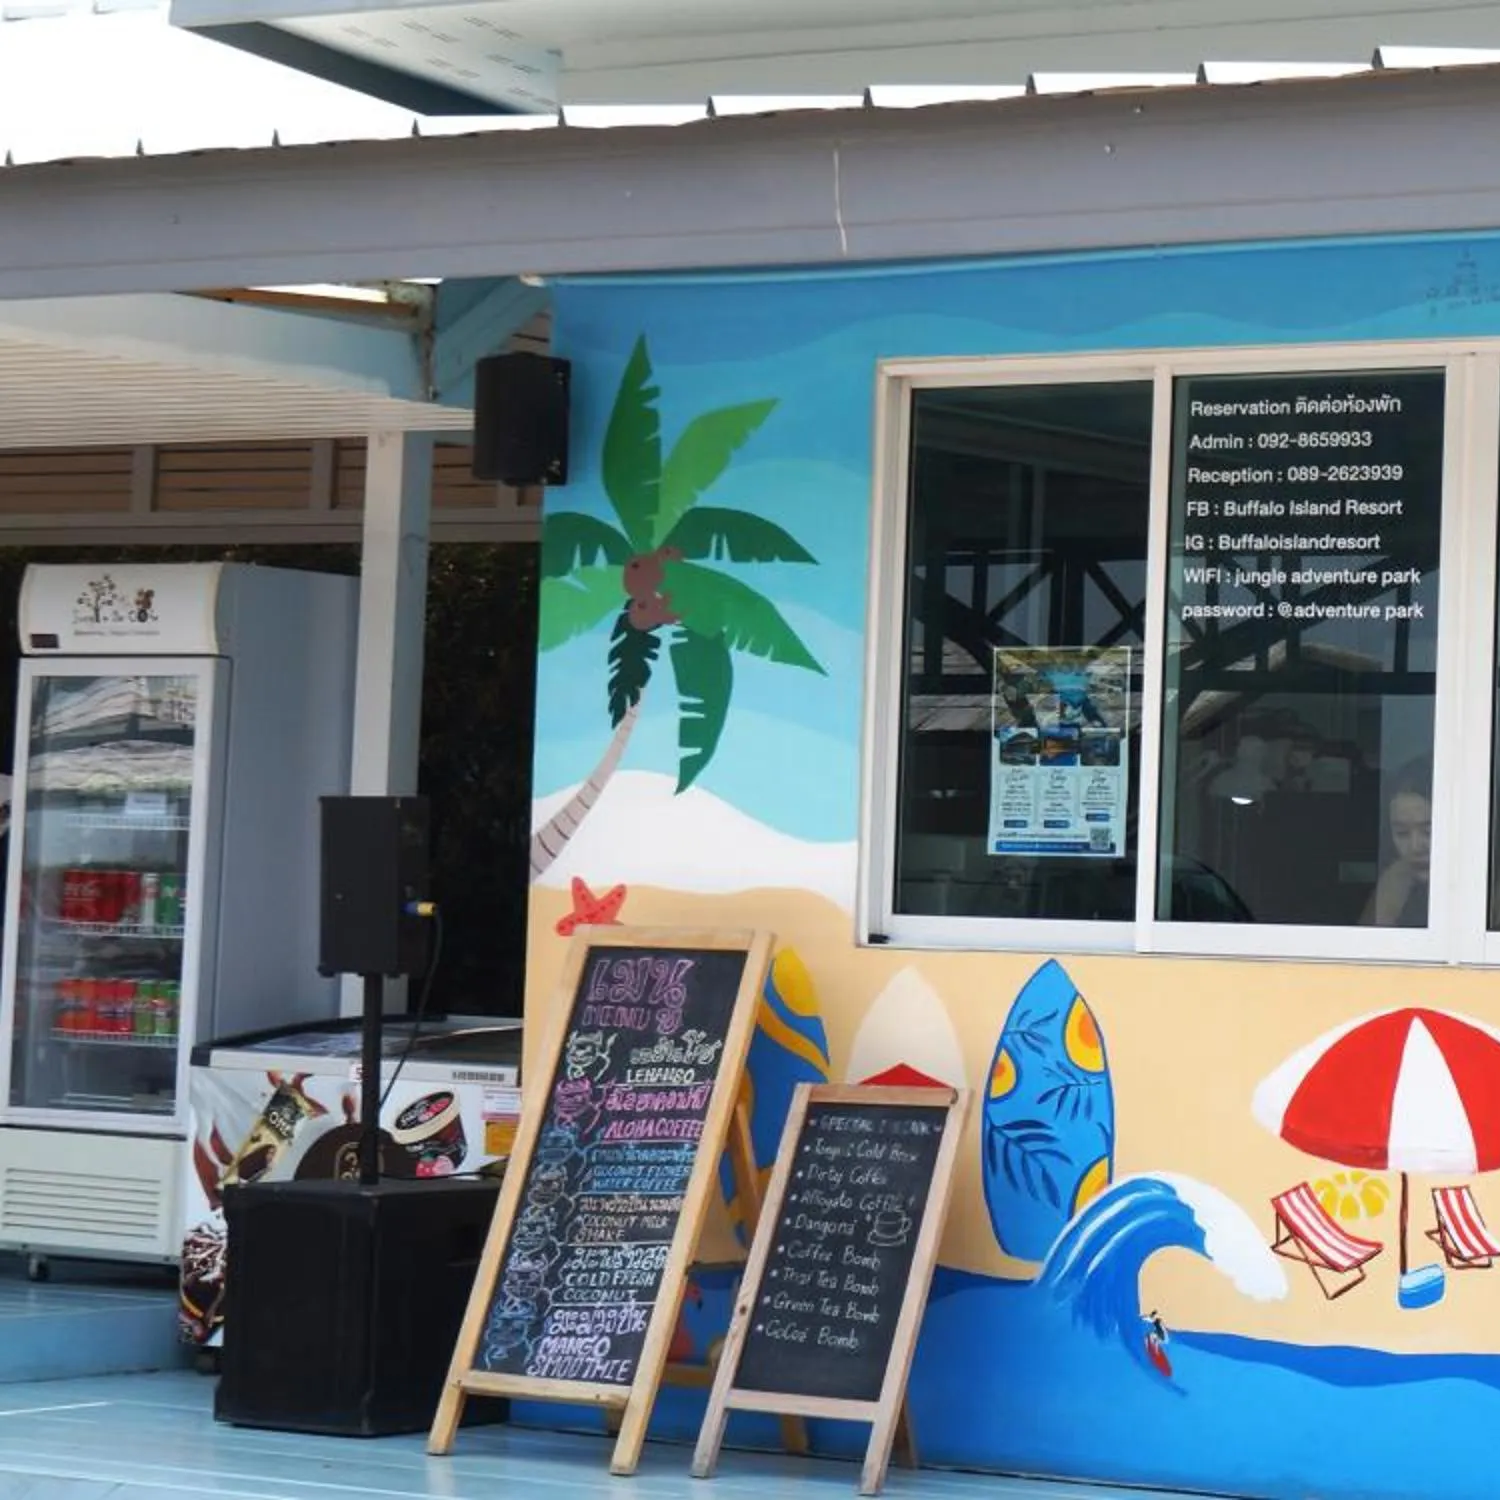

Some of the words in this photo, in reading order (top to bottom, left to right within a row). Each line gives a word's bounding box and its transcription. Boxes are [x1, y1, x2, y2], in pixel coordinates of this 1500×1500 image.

[1190, 401, 1290, 417] Reservation
[1295, 393, 1401, 414] ติดต่อห้องพัก
[1189, 433, 1243, 450] Admin
[1257, 431, 1373, 448] 092-8659933
[1188, 466, 1273, 485] Reception
[1287, 465, 1403, 481] 089-2623939
[1186, 501, 1209, 516] FB
[1223, 499, 1285, 516] Buffalo
[1289, 499, 1341, 515] Island
[1345, 499, 1403, 515] Resort
[1185, 535, 1204, 550] IG
[1218, 534, 1381, 550] Buffaloislandresort
[1234, 568, 1286, 587] jungle
[1291, 568, 1377, 584] adventure
[1381, 567, 1421, 586] park
[1181, 602, 1264, 620] password
[1384, 601, 1425, 620] park
[604, 1118, 655, 1139] ALOHA
[841, 1244, 882, 1272] Bomb
[565, 1271, 611, 1287] COLD
[817, 1269, 839, 1290] Tea
[843, 1272, 880, 1297] Bomb
[819, 1296, 841, 1317] Tea
[845, 1300, 880, 1324] Bomb
[538, 1335, 611, 1358] MANGO
[817, 1325, 861, 1350] Bomb
[525, 1354, 633, 1382] SMOOTHIE
